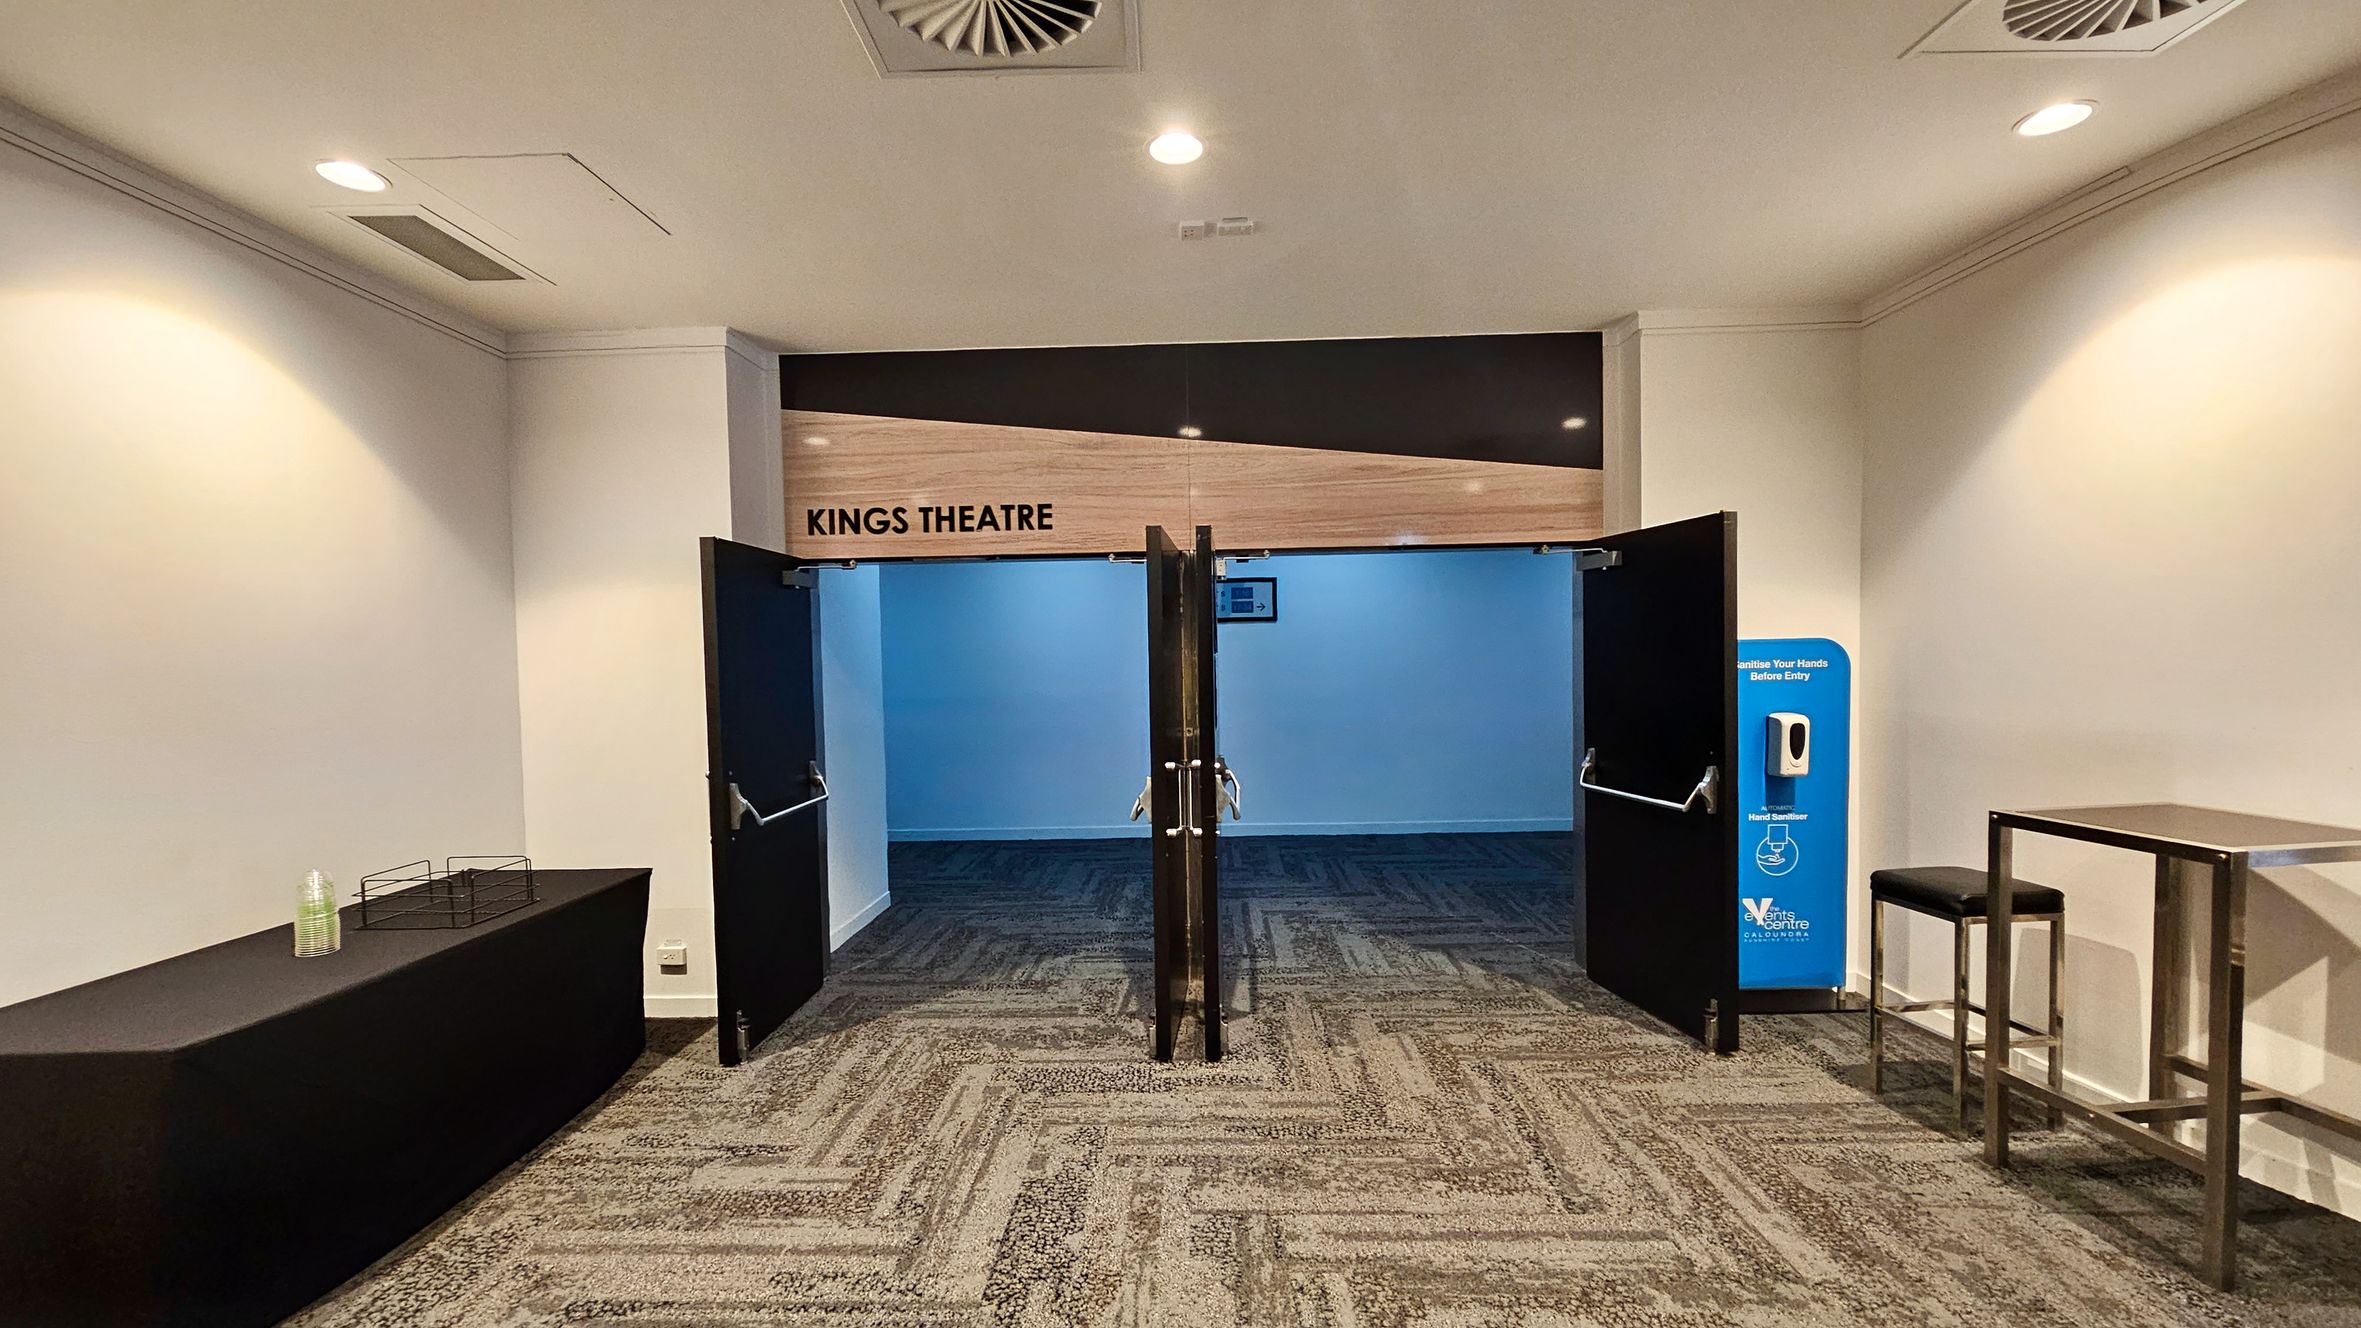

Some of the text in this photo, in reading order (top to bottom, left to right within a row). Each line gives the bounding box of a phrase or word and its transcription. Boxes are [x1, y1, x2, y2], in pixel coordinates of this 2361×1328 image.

[807, 503, 1053, 536] KINGS THEATRE
[1772, 659, 1796, 669] Your
[1797, 658, 1828, 668] Hands
[1750, 671, 1811, 682] Before Entry
[1748, 812, 1809, 821] Hand Sanitiser
[1764, 919, 1810, 930] centre
